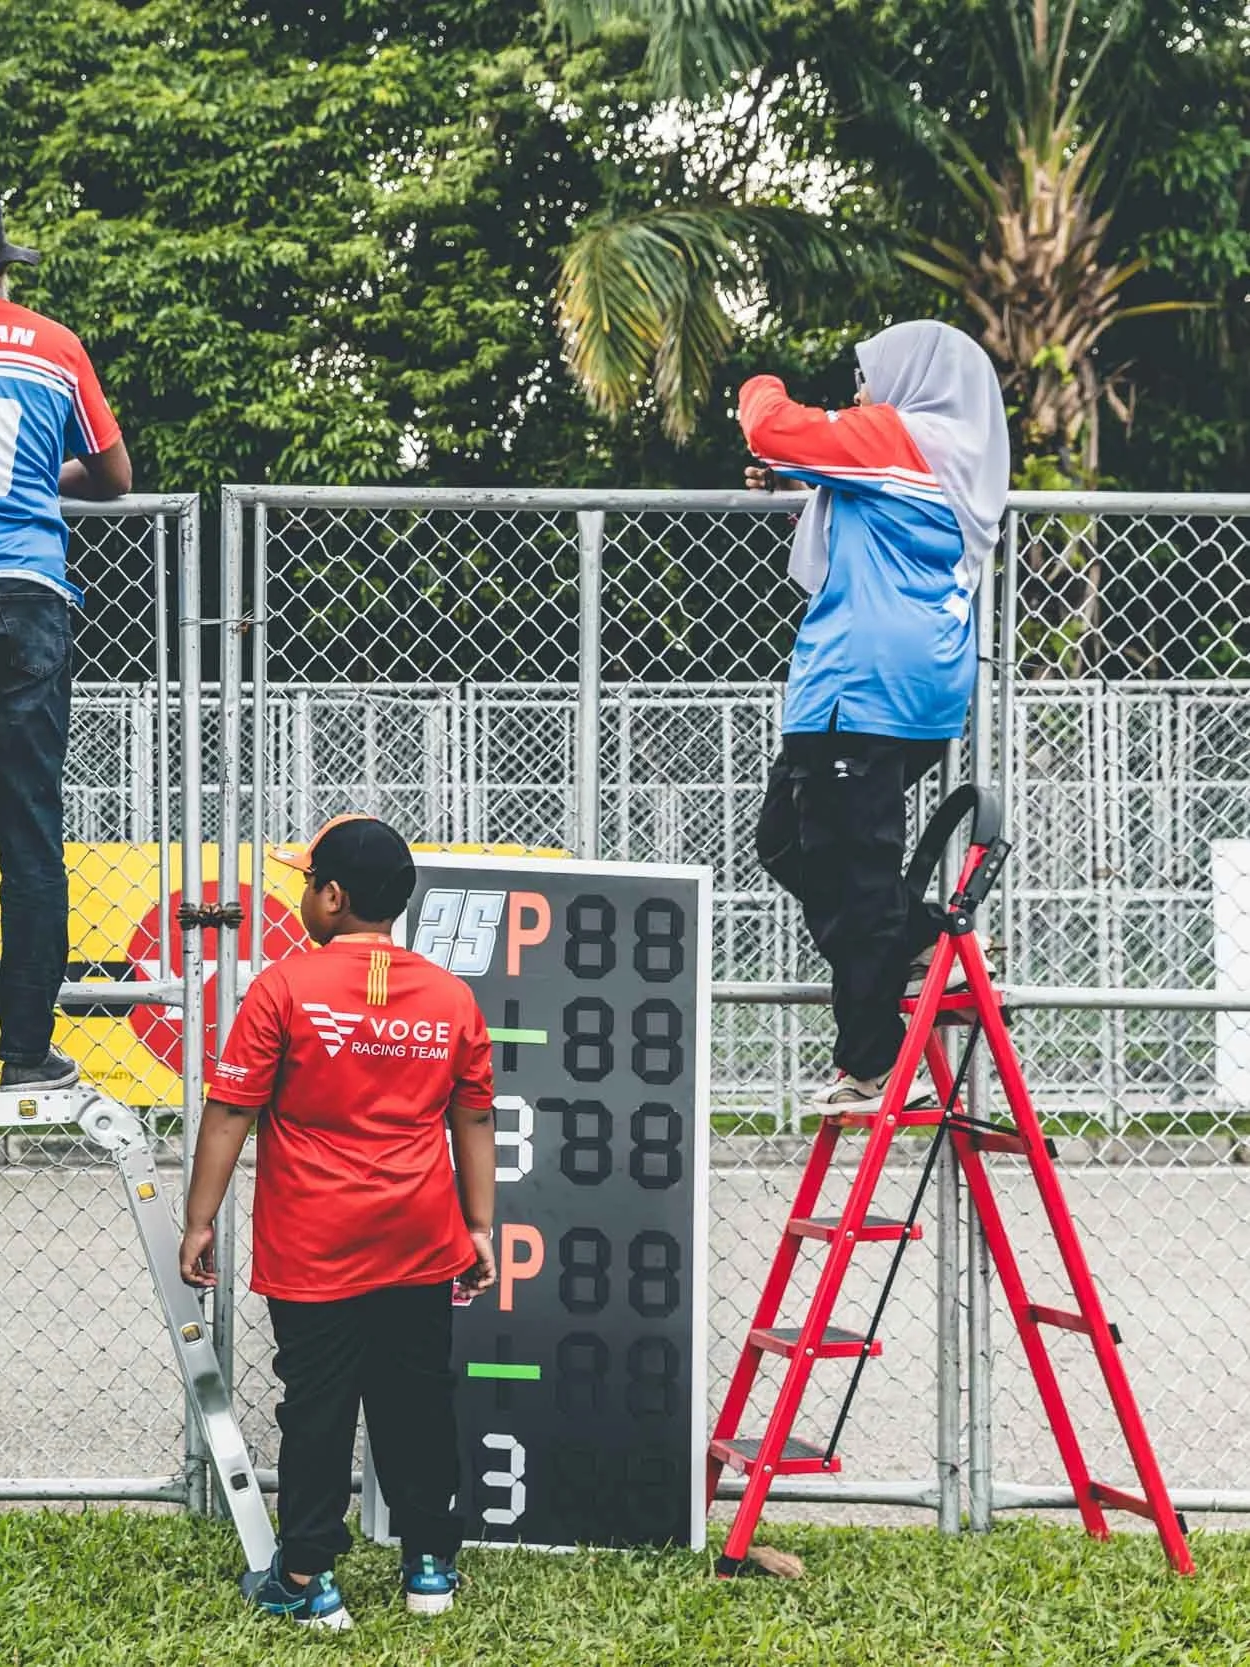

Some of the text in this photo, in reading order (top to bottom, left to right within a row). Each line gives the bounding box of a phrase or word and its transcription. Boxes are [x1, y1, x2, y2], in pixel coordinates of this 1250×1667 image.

[351, 1042, 449, 1060] RACING TEAM
[370, 1017, 450, 1043] VOGE
[499, 1223, 545, 1312] P
[482, 1433, 526, 1525] 3
